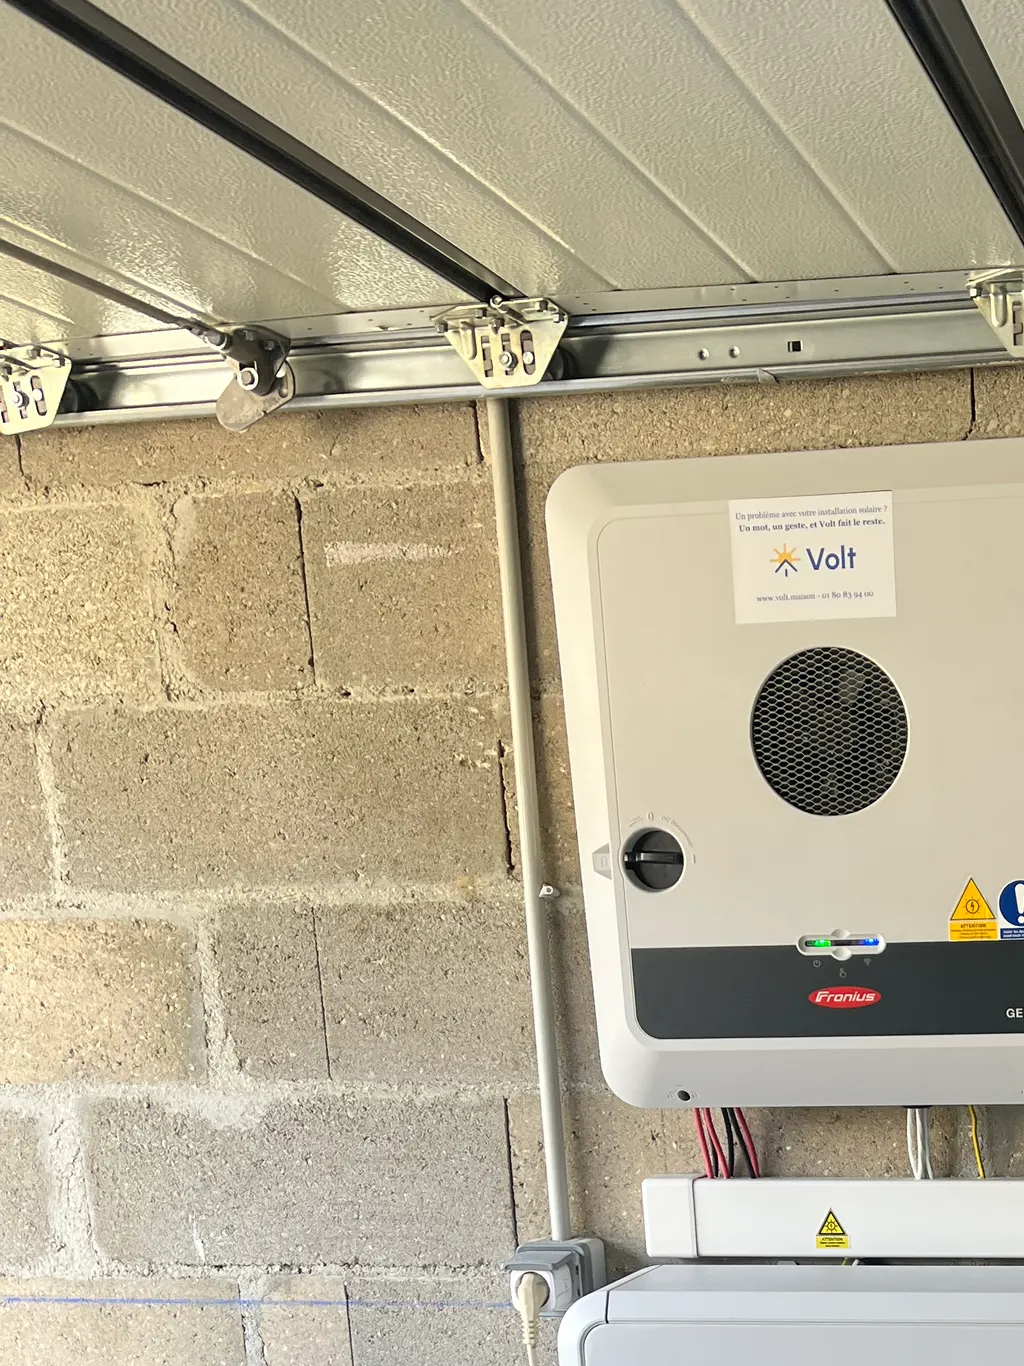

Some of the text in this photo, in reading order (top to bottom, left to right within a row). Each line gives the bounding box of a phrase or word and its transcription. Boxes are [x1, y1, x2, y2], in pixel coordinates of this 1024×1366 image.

[735, 512, 746, 520] Un
[747, 511, 780, 521] problème
[818, 506, 857, 516] installation
[858, 505, 882, 514] solaire
[883, 504, 888, 512] ?
[739, 524, 751, 532] Un
[752, 524, 771, 532] mot,
[784, 522, 809, 531] geste,
[809, 521, 817, 529] et
[819, 520, 836, 528] Volt
[838, 519, 852, 527] fait
[853, 518, 861, 526] le
[862, 518, 885, 526] reste.
[805, 545, 857, 571] Volt
[756, 593, 816, 602] www.volt.maison
[831, 591, 841, 599] 80
[842, 591, 852, 599] 83
[853, 591, 863, 599] 94
[814, 990, 876, 1003] Fronius
